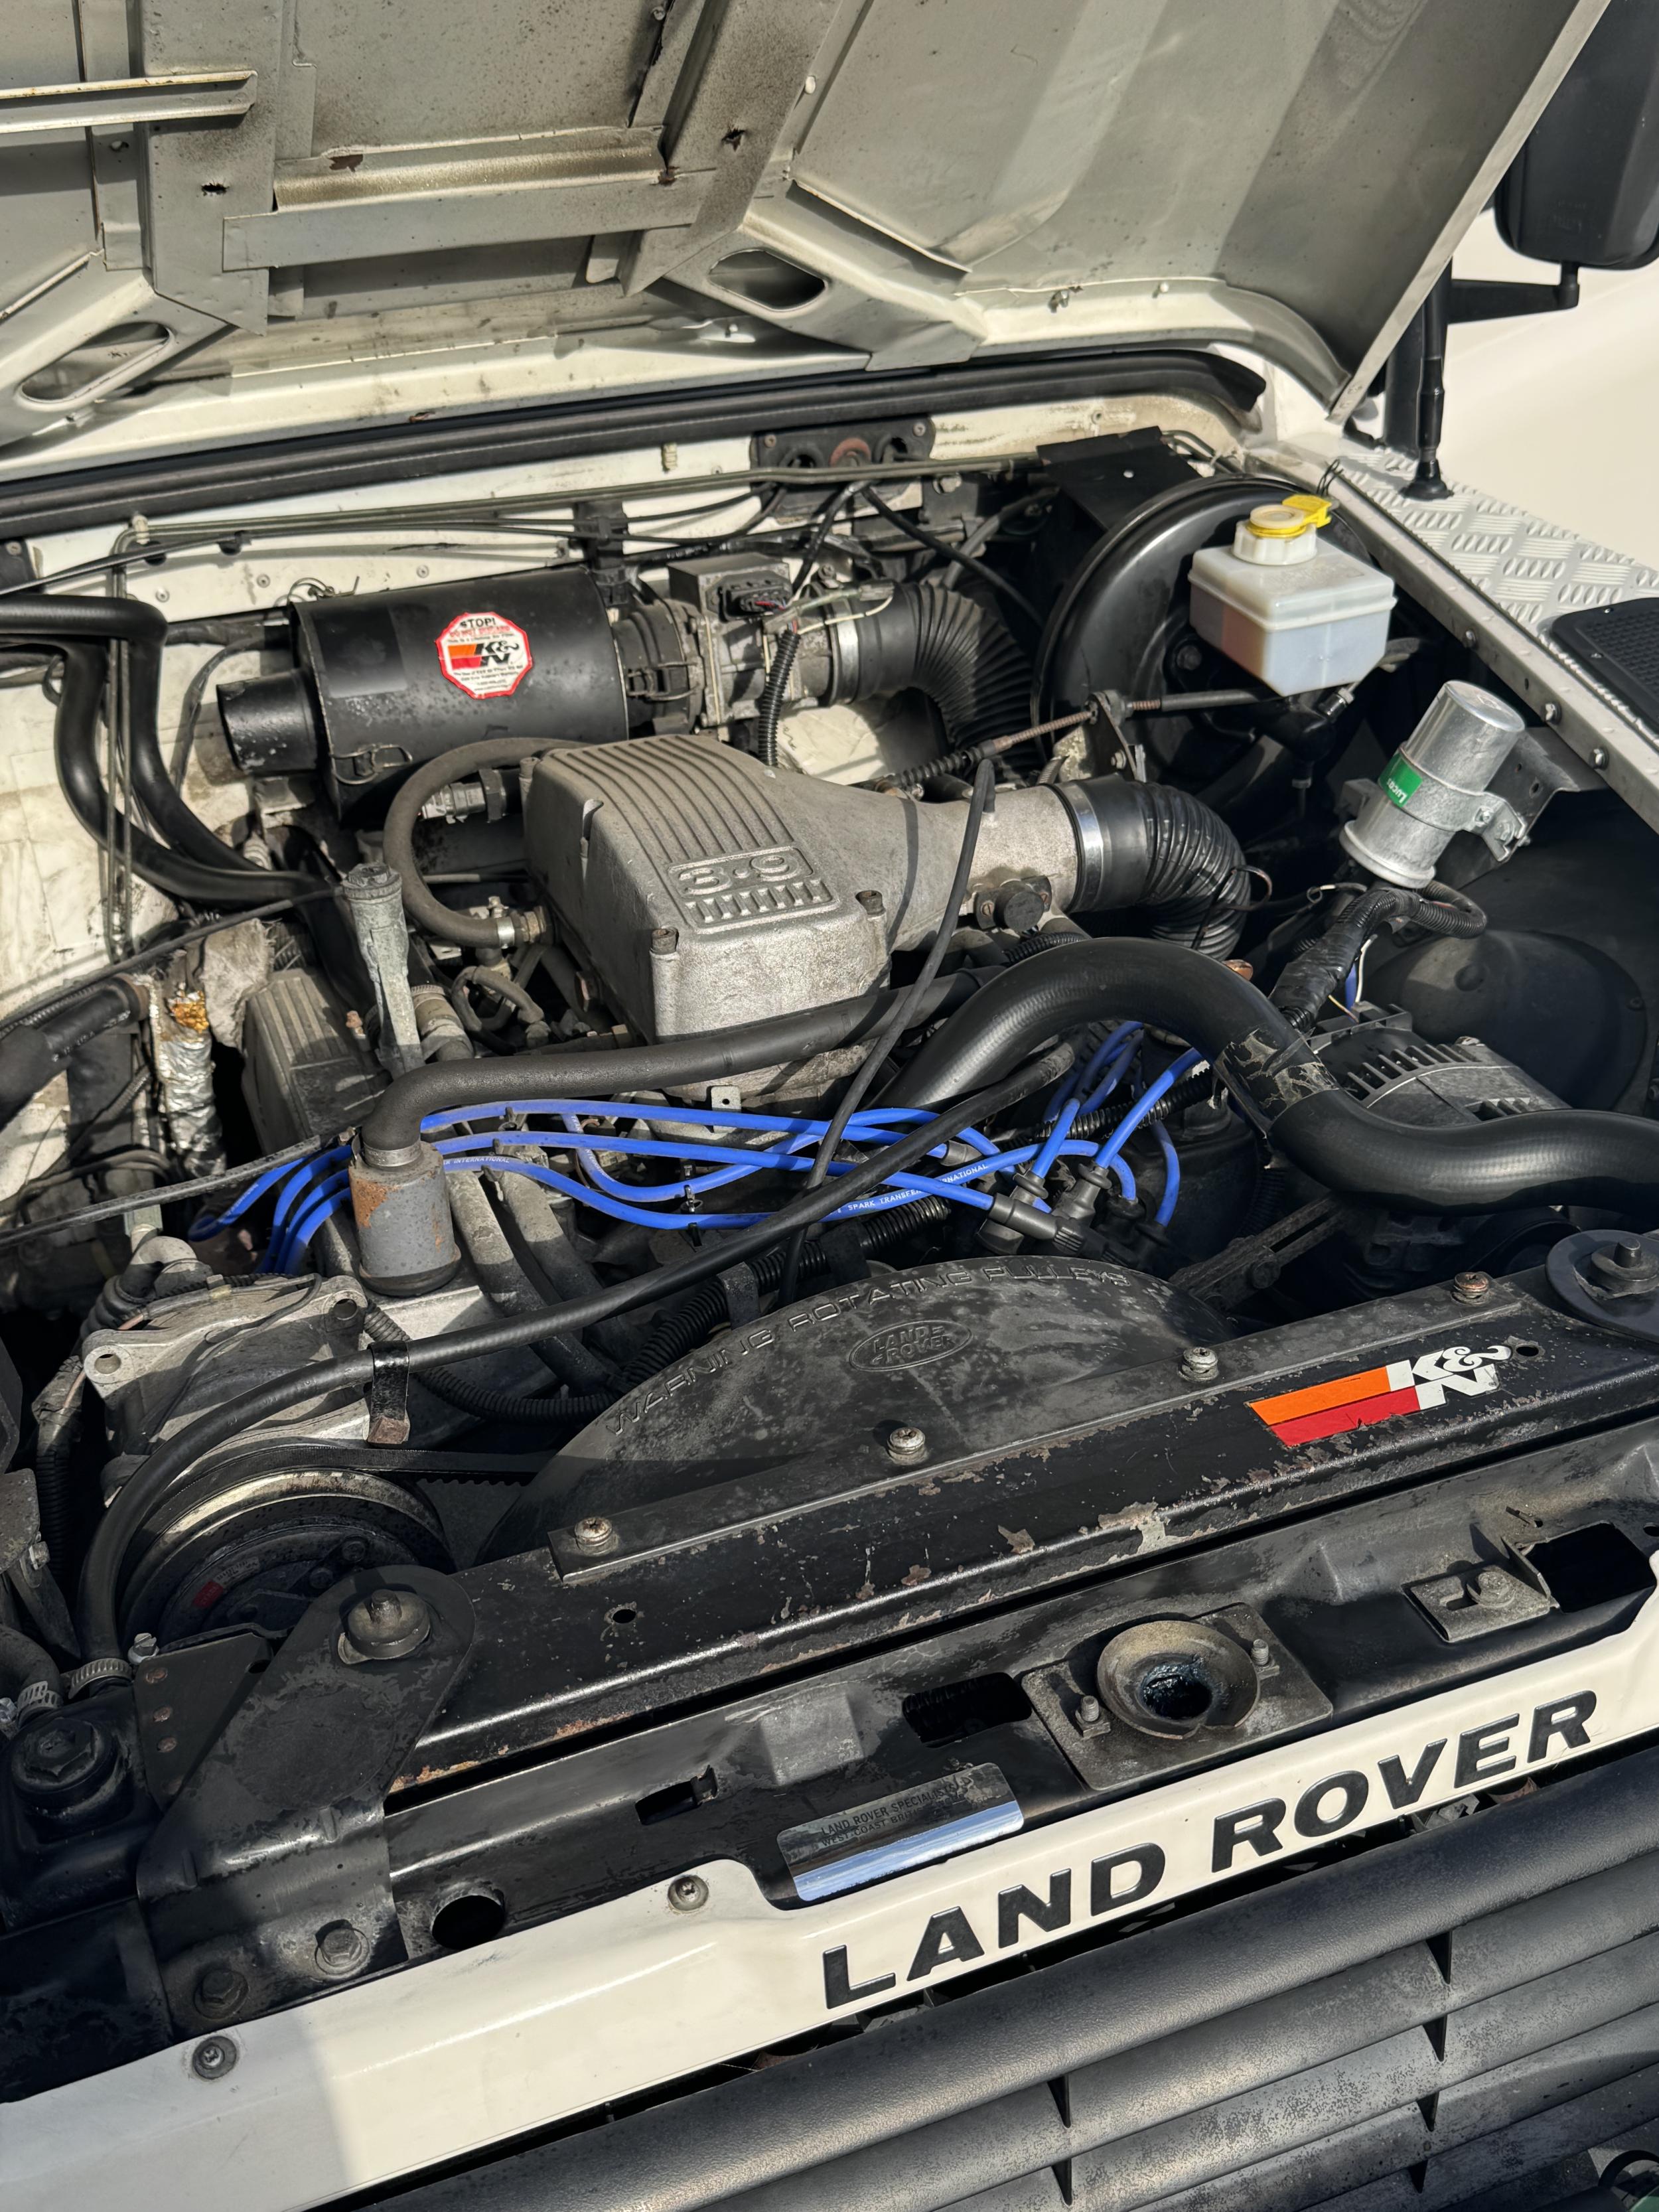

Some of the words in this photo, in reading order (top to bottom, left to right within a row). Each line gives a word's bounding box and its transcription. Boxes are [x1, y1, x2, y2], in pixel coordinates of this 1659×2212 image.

[460, 618, 496, 628] STOP!
[474, 640, 520, 667] K&N
[678, 855, 802, 895] 3.9
[847, 1199, 875, 1211] SPARK
[940, 1163, 989, 1183] RNATIONAL
[605, 1328, 776, 1436] WARNING
[786, 1270, 974, 1333] ROTATING
[981, 1264, 1131, 1287] PULLEYS
[873, 1326, 929, 1353] LAND
[1386, 1345, 1513, 1410] K&N
[821, 1819, 850, 1836] LAND
[853, 1806, 890, 1825] ROVER
[821, 1832, 850, 1846] WEST
[854, 1819, 886, 1836] COAST
[890, 1806, 925, 1824] BRITI
[821, 1840, 1167, 2010] LAND
[1211, 1688, 1598, 1874] ROVER
